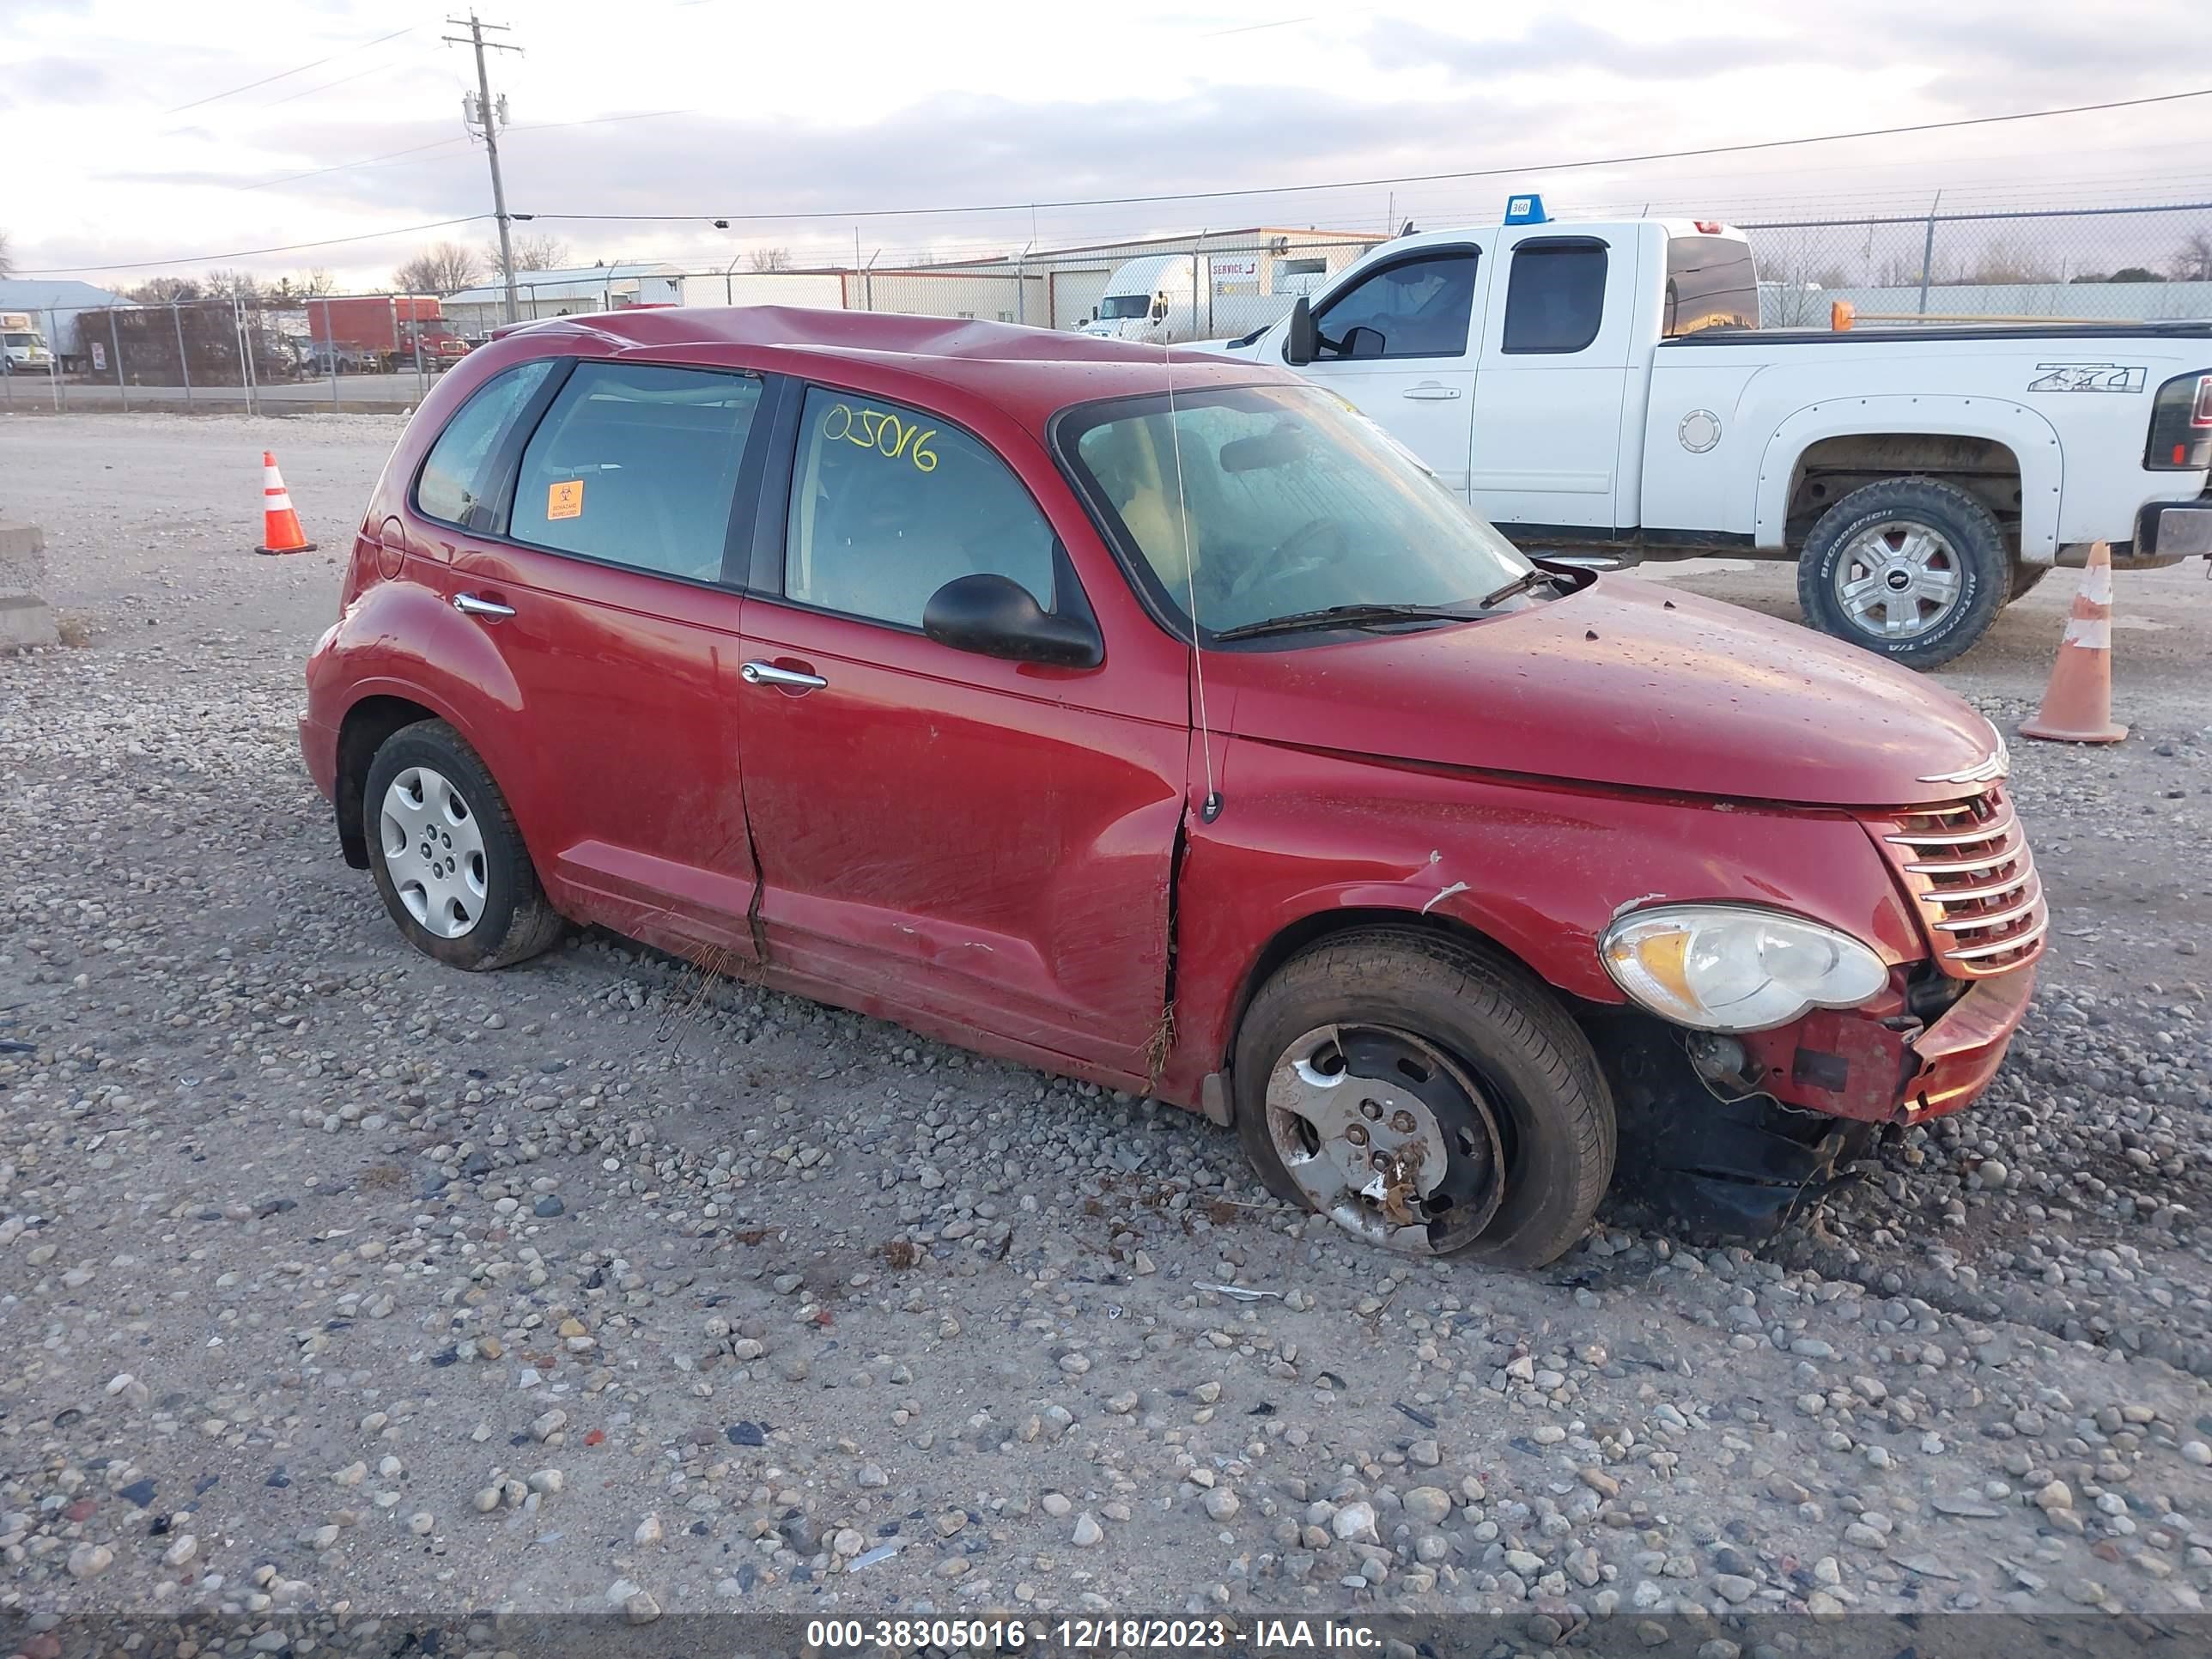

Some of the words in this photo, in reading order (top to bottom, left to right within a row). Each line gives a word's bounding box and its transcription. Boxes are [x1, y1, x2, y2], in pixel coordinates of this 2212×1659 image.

[1212, 264, 1243, 275] SERVICE
[2027, 362, 2148, 393] Z71
[823, 404, 939, 472] 05016
